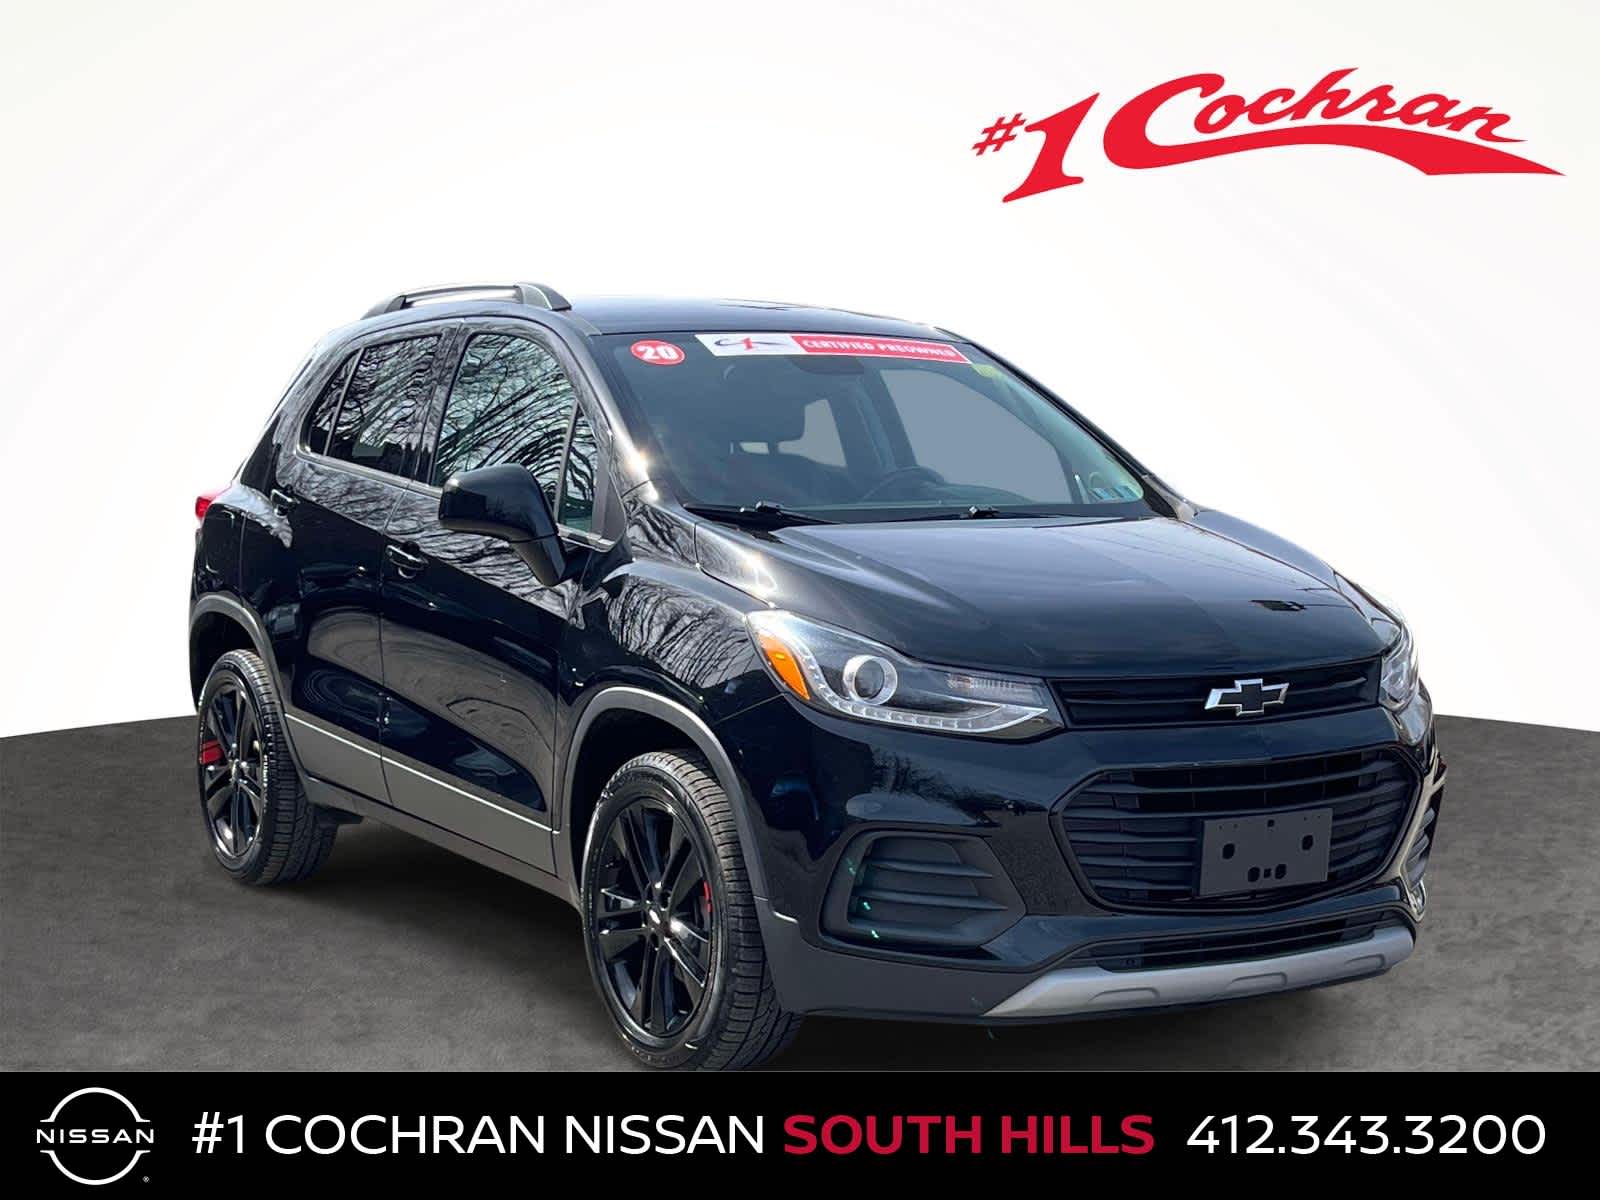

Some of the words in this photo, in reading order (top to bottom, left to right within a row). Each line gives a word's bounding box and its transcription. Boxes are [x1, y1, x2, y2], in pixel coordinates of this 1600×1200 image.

[637, 344, 680, 360] 20
[802, 339, 875, 351] CERTIFIED
[878, 343, 958, 357] PREOWNED
